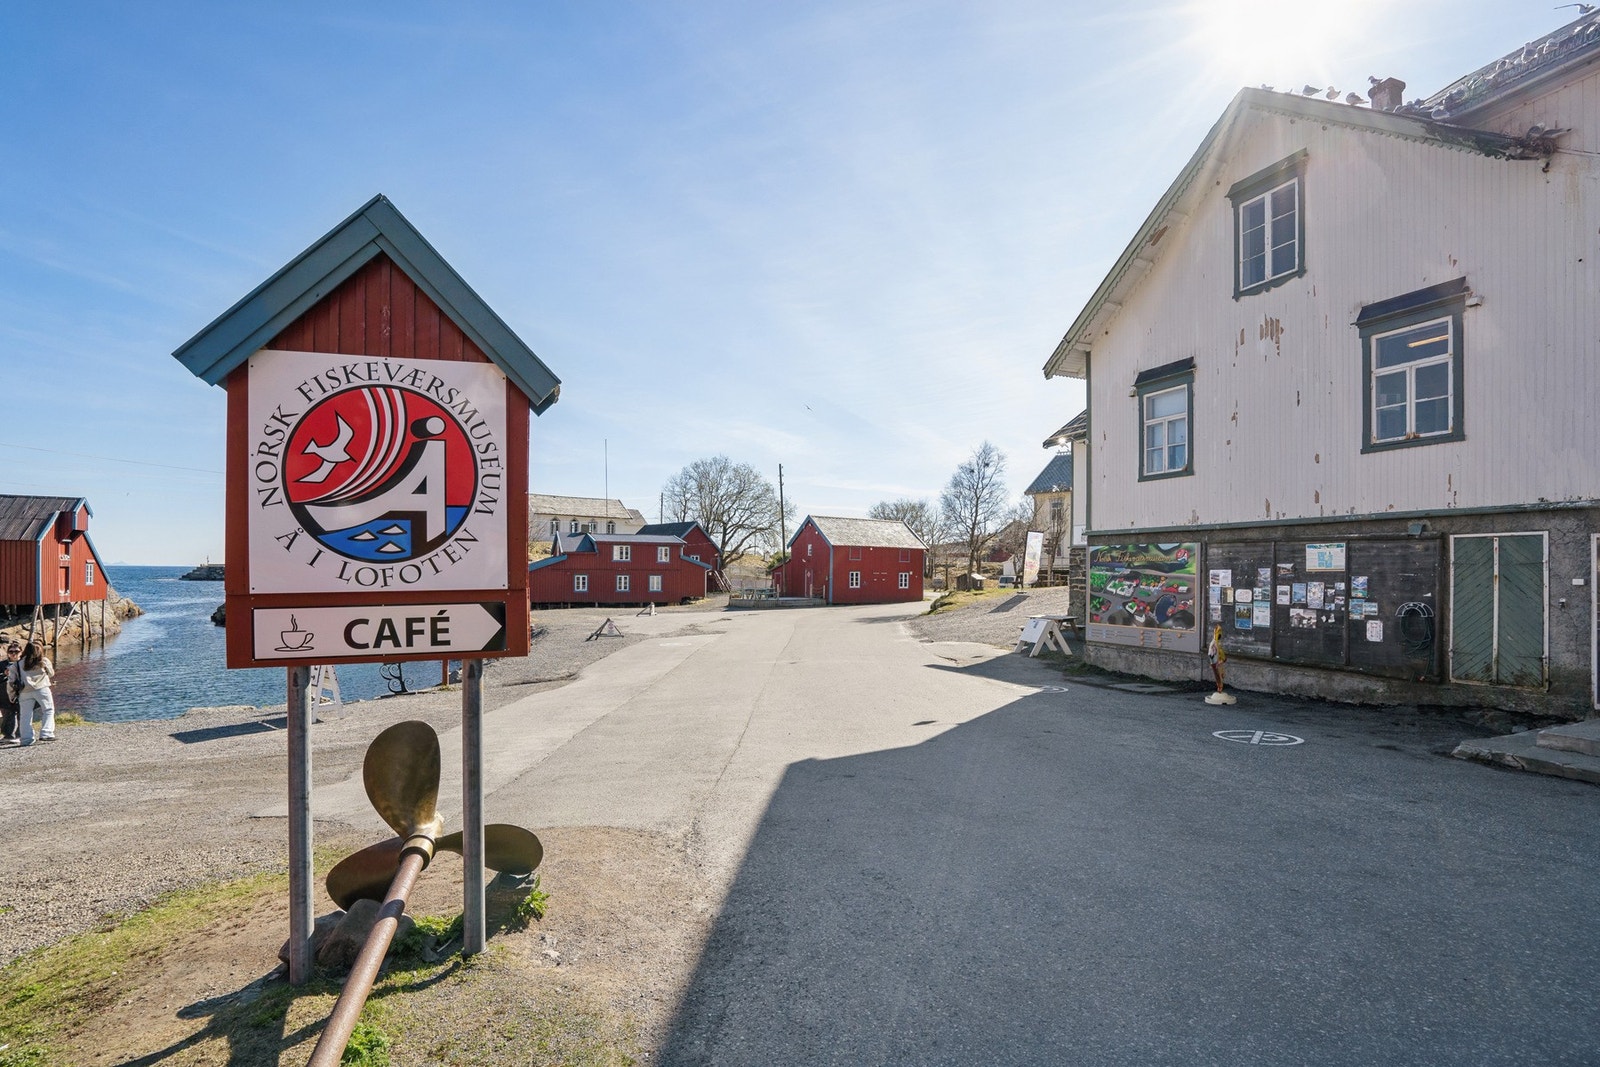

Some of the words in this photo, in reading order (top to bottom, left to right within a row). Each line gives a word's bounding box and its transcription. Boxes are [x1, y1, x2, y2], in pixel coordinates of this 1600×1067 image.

[255, 404, 299, 509] NORSK
[295, 361, 501, 516] FISKEVÆRSMUSEUM
[274, 527, 304, 552] Å
[335, 527, 479, 588] LOFOTEN
[343, 609, 451, 650] CAFÉ
